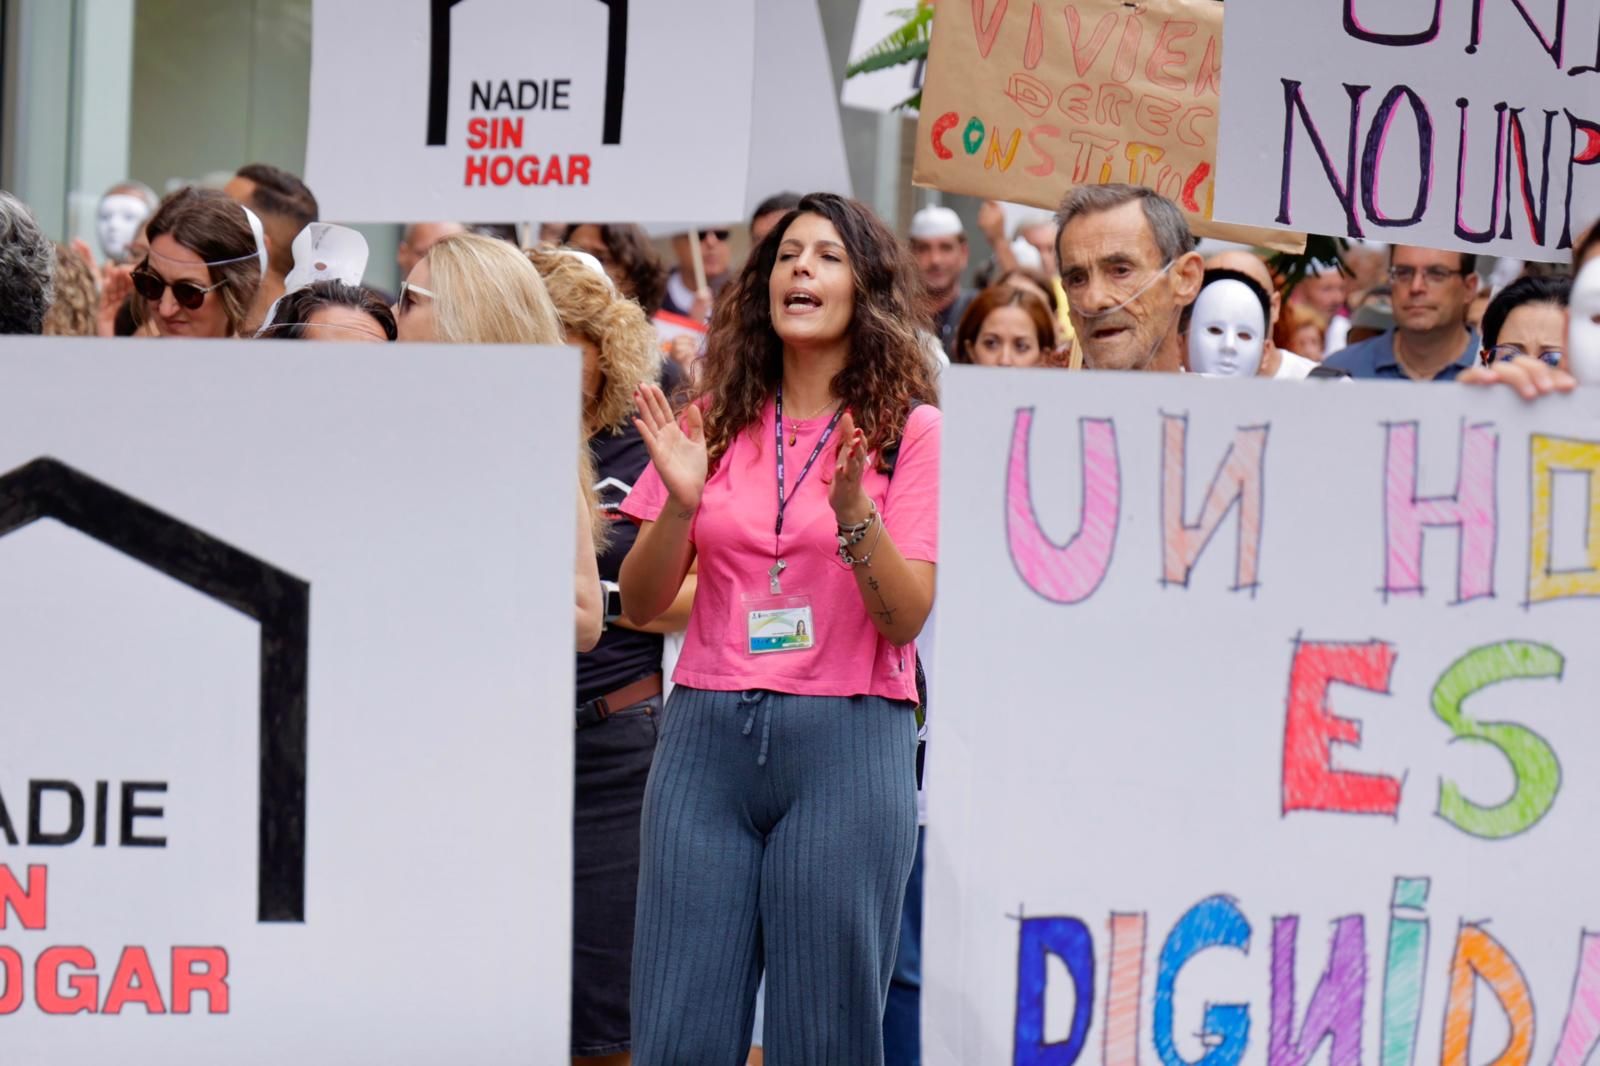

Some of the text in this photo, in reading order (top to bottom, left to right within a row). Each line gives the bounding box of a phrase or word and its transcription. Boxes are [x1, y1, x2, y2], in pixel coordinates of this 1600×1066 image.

[466, 117, 524, 150] SIN
[470, 79, 571, 110] NADIE
[464, 154, 591, 187] HOGAR
[1275, 78, 1435, 239] NO
[1005, 405, 1270, 605] UN
[1280, 630, 1566, 840] ES
